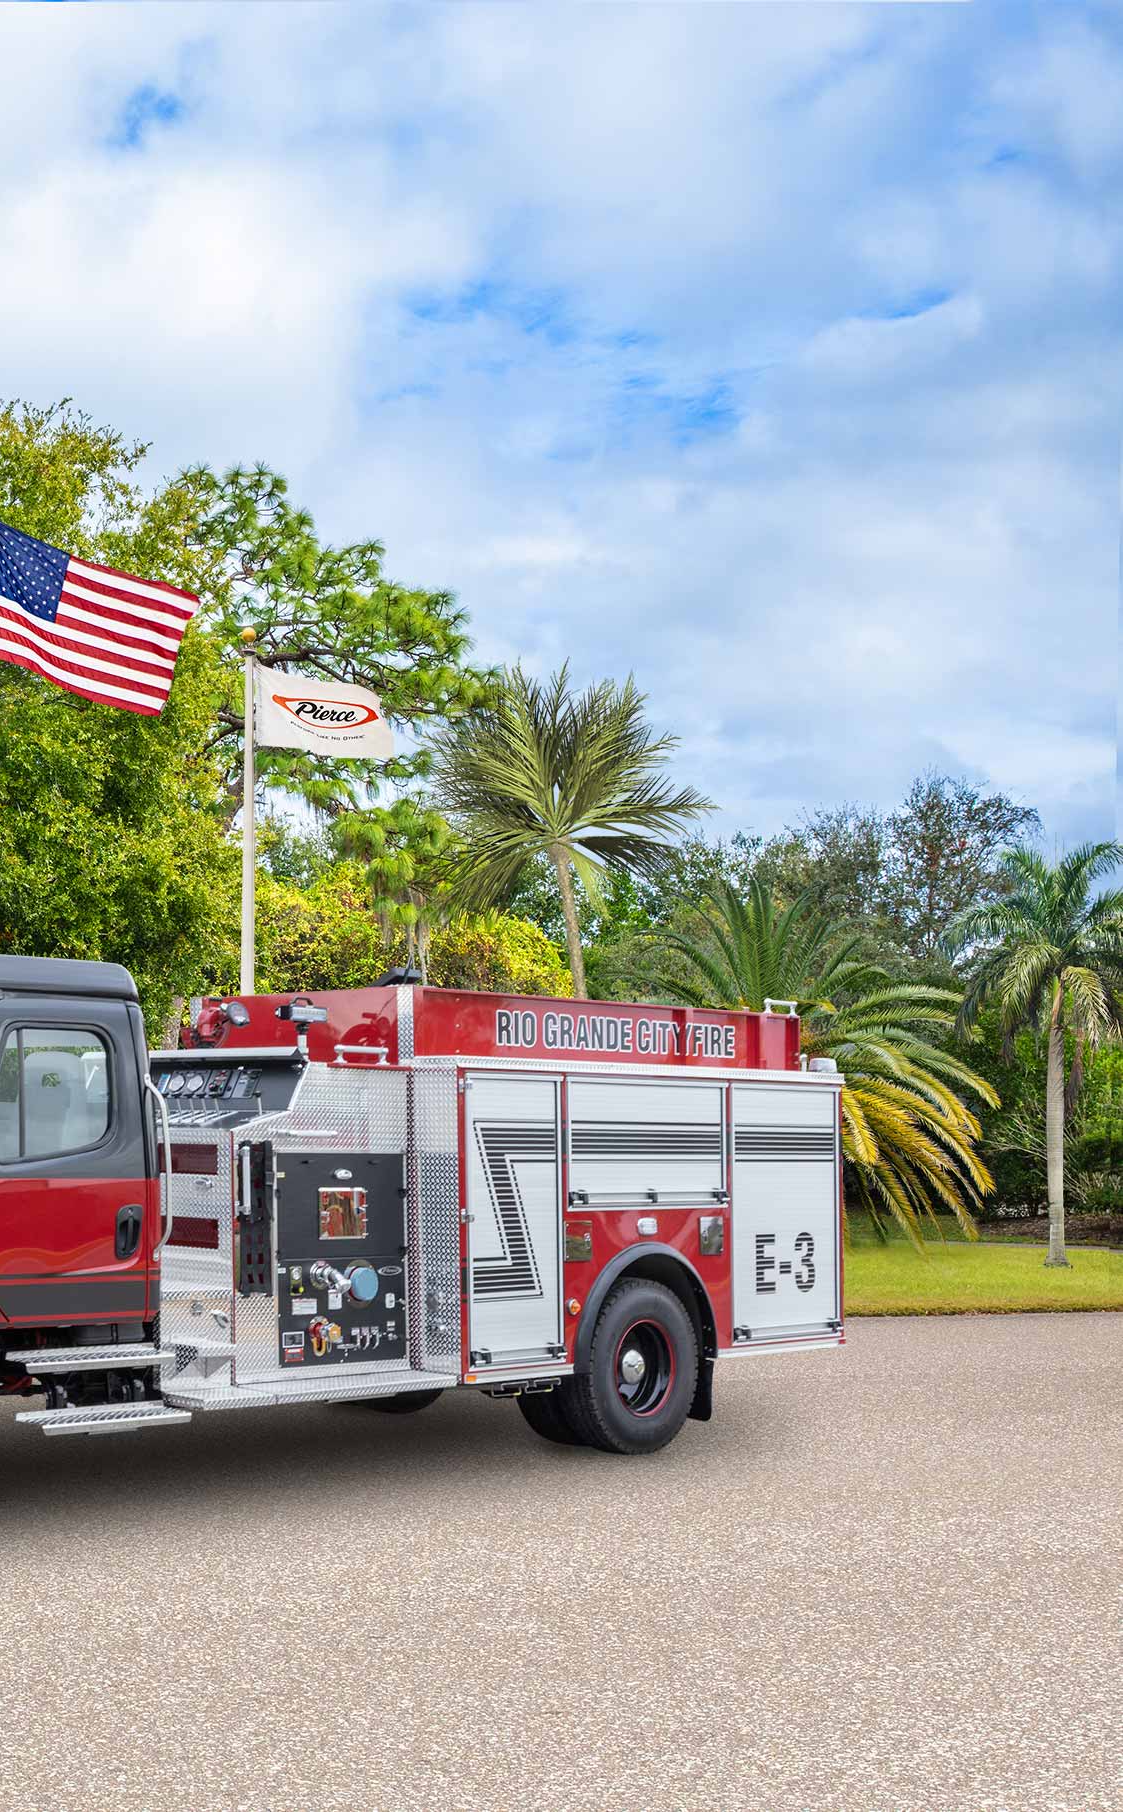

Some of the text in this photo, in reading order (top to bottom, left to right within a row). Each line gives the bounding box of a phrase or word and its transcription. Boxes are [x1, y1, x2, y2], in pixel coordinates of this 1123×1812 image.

[295, 702, 356, 722] Pierce
[496, 1010, 736, 1059] RIO GRANDE CITY FIRE
[755, 1231, 816, 1295] E-3
